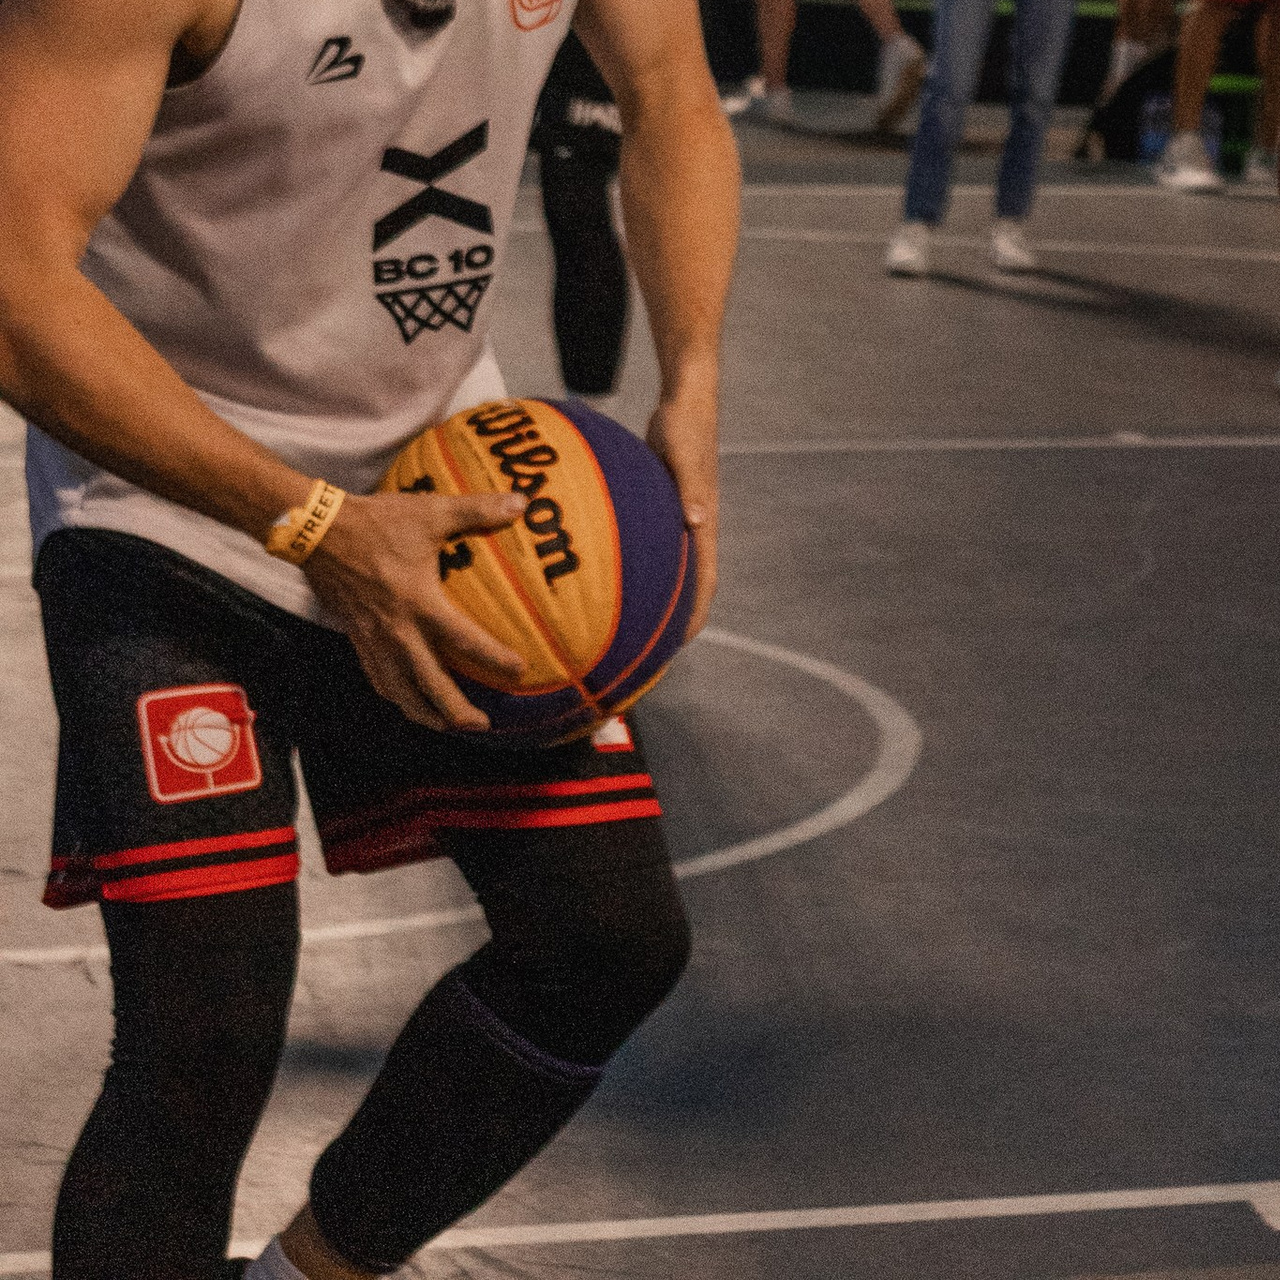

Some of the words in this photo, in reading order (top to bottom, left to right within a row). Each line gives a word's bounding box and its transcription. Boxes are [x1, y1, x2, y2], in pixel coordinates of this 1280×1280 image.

[373, 253, 440, 286] BC
[448, 244, 495, 274] 10
[290, 486, 337, 553] STREET
[467, 403, 580, 588] Wilson
